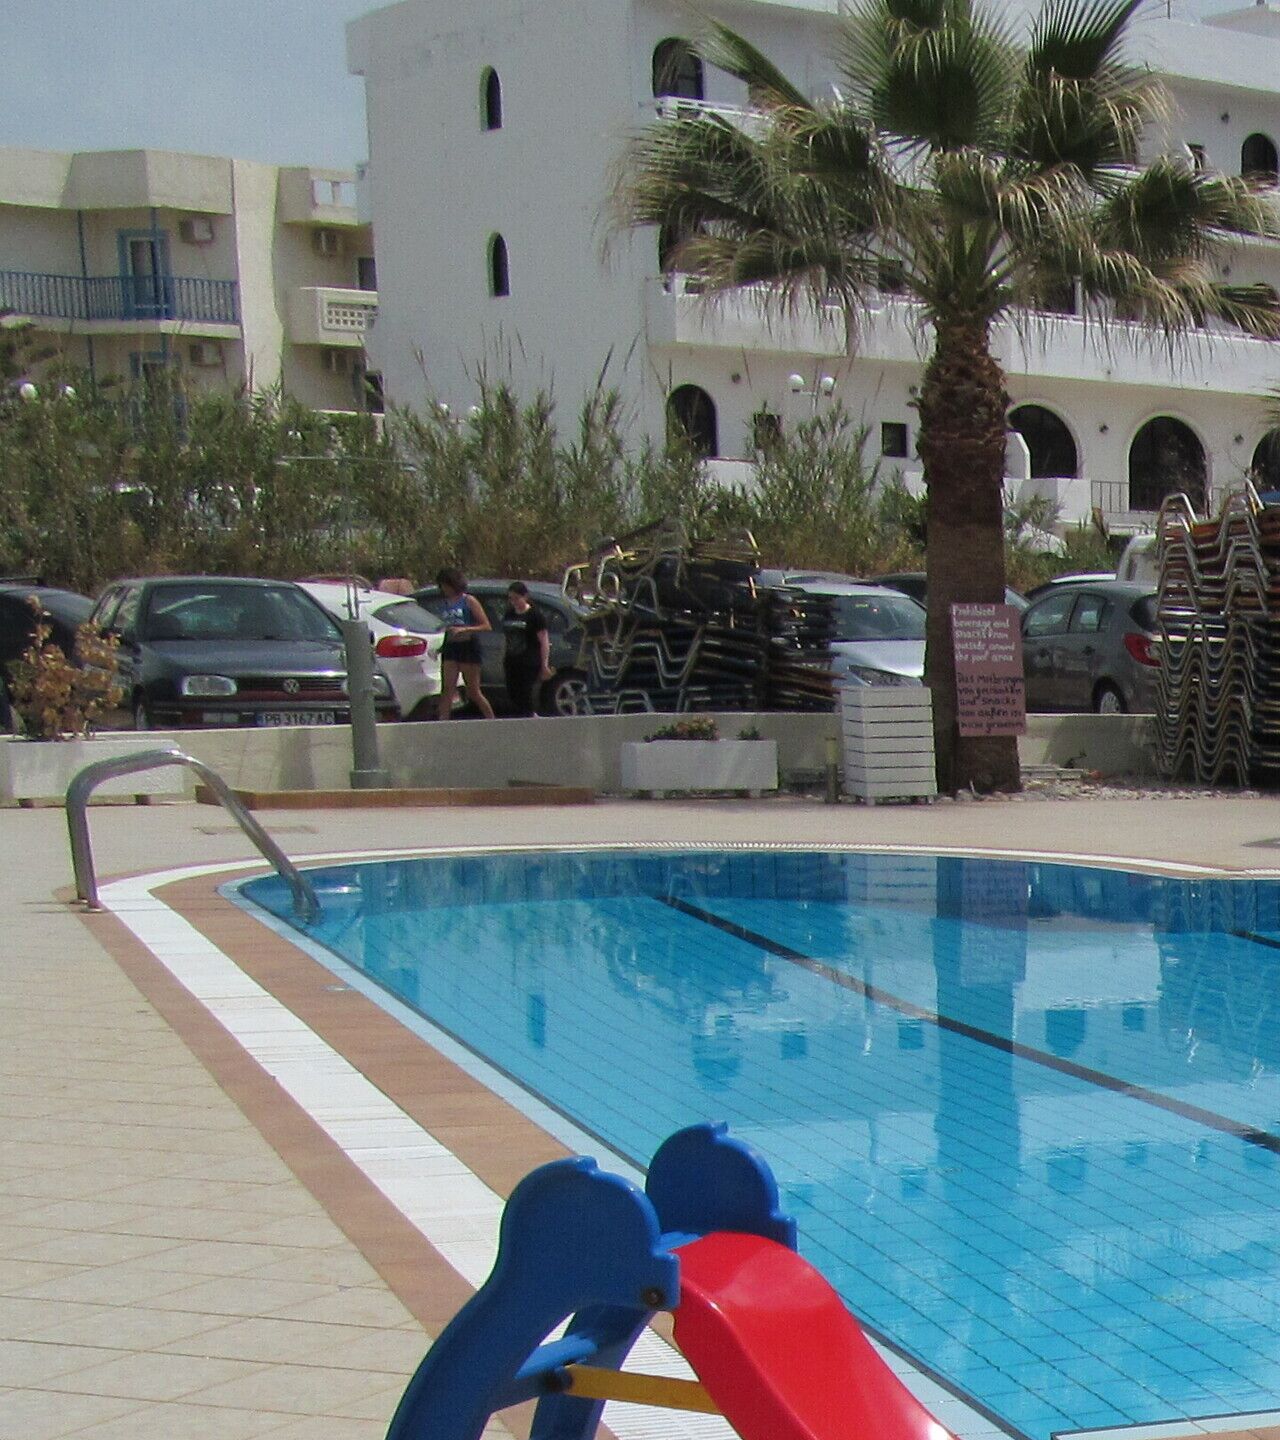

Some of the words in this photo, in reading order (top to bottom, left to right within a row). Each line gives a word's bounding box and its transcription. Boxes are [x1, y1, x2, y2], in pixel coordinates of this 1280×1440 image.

[992, 618, 1010, 627] and
[971, 650, 990, 663] pool
[991, 654, 1014, 662] area
